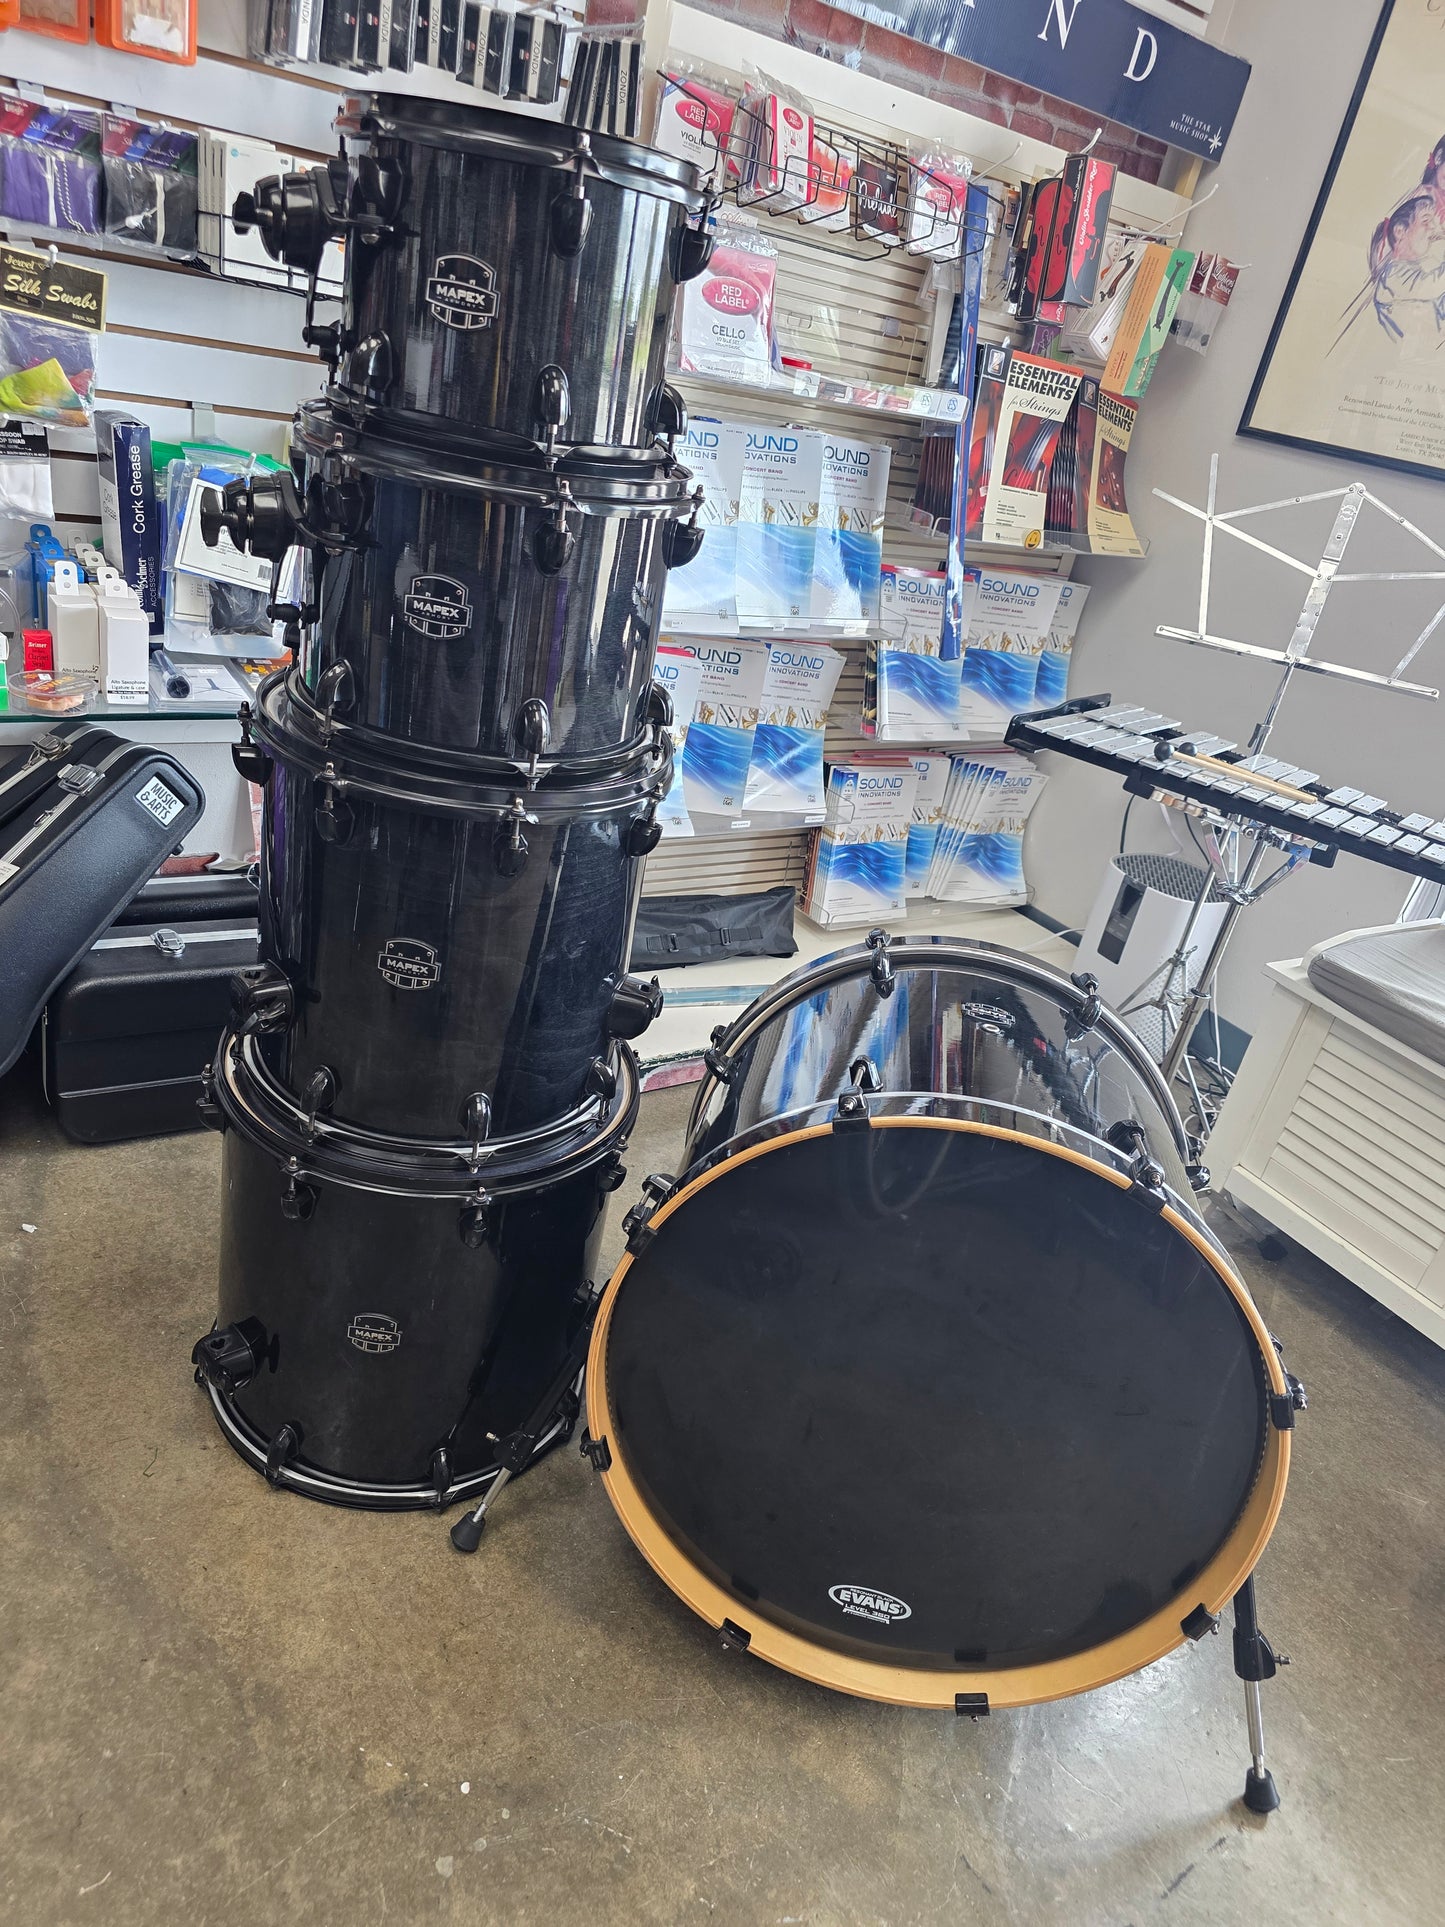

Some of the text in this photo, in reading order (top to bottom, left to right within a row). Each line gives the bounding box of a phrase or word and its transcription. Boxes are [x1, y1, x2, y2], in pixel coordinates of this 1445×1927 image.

[381, 4, 391, 43] ZONDA
[431, 7, 440, 44] ZONDA
[477, 31, 487, 67] ZONDA
[531, 40, 541, 75] ZONDA
[619, 70, 628, 104] ZONDA
[690, 105, 706, 116] RED
[1170, 120, 1208, 141] MUSIC SHOP
[1181, 113, 1211, 132] THE STAR
[1080, 161, 1098, 246] Violin Shoulder Rest
[4, 254, 35, 270] Jewel
[3, 274, 42, 296] Silk
[45, 285, 98, 311] Swabs
[435, 283, 485, 306] MAPEX
[721, 284, 742, 298] RED
[445, 297, 477, 308] ARMORY
[712, 324, 746, 340] CELLO
[1009, 361, 1078, 390] ESSENTIAL
[1008, 376, 1074, 401] ELEMENTS
[1007, 395, 1062, 424] for Strings
[1099, 392, 1135, 422] ESSENTIAL
[1344, 395, 1443, 419] Renowned Laredo Artist Armando
[1099, 405, 1133, 433] ELEMENTS
[1105, 427, 1127, 447] Strings
[824, 445, 870, 465] OUND
[130, 445, 147, 534] Cork Grease
[147, 556, 157, 607] ACCESSORIES
[982, 579, 1040, 598] SOUND
[413, 600, 460, 619] MAPEX
[980, 593, 1036, 607] INNOVATIONS
[771, 651, 824, 670] SOUND
[769, 667, 820, 679] INNOVATIONS
[859, 777, 903, 789] SOUND
[1002, 777, 1032, 788] SOUND
[140, 791, 169, 820] & ARTS
[150, 782, 177, 810] MUSIC
[386, 958, 428, 974] MAPEX
[355, 1329, 393, 1341] MAPEX
[840, 1589, 901, 1615] EVANS
[845, 1603, 870, 1614] LEVEL
[872, 1611, 891, 1620] 360
